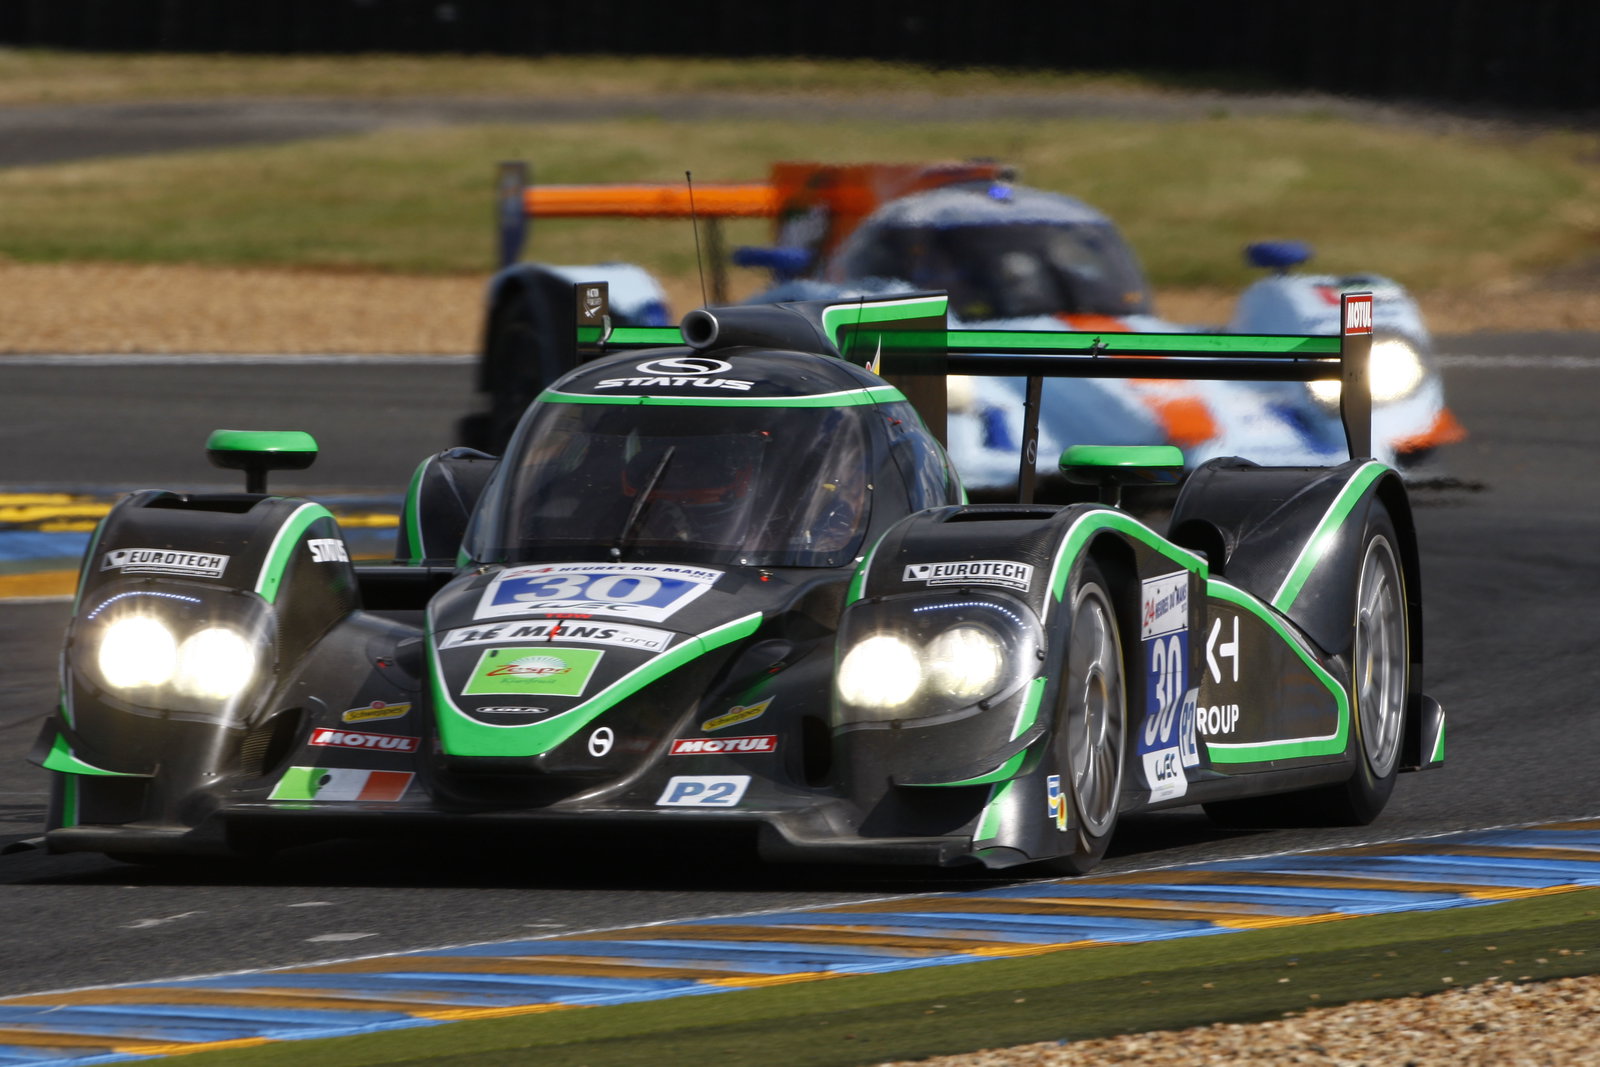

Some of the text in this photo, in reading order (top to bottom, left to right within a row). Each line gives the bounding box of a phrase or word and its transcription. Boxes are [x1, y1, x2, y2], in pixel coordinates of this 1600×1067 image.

[1347, 301, 1371, 328] MOTUL
[594, 376, 755, 391] STATUS
[129, 551, 222, 568] EUROTECH
[503, 567, 555, 579] 24
[661, 567, 718, 578] MANS
[934, 563, 1026, 580] EUROTECH
[513, 574, 661, 603] 30
[528, 602, 640, 611] WEC
[1143, 598, 1155, 627] 24
[486, 664, 572, 677] Zespri
[1145, 635, 1182, 746] 30
[1183, 701, 1196, 756] P2
[314, 731, 412, 750] MOTUL
[675, 738, 770, 753] MOTUL
[667, 782, 737, 804] P2
